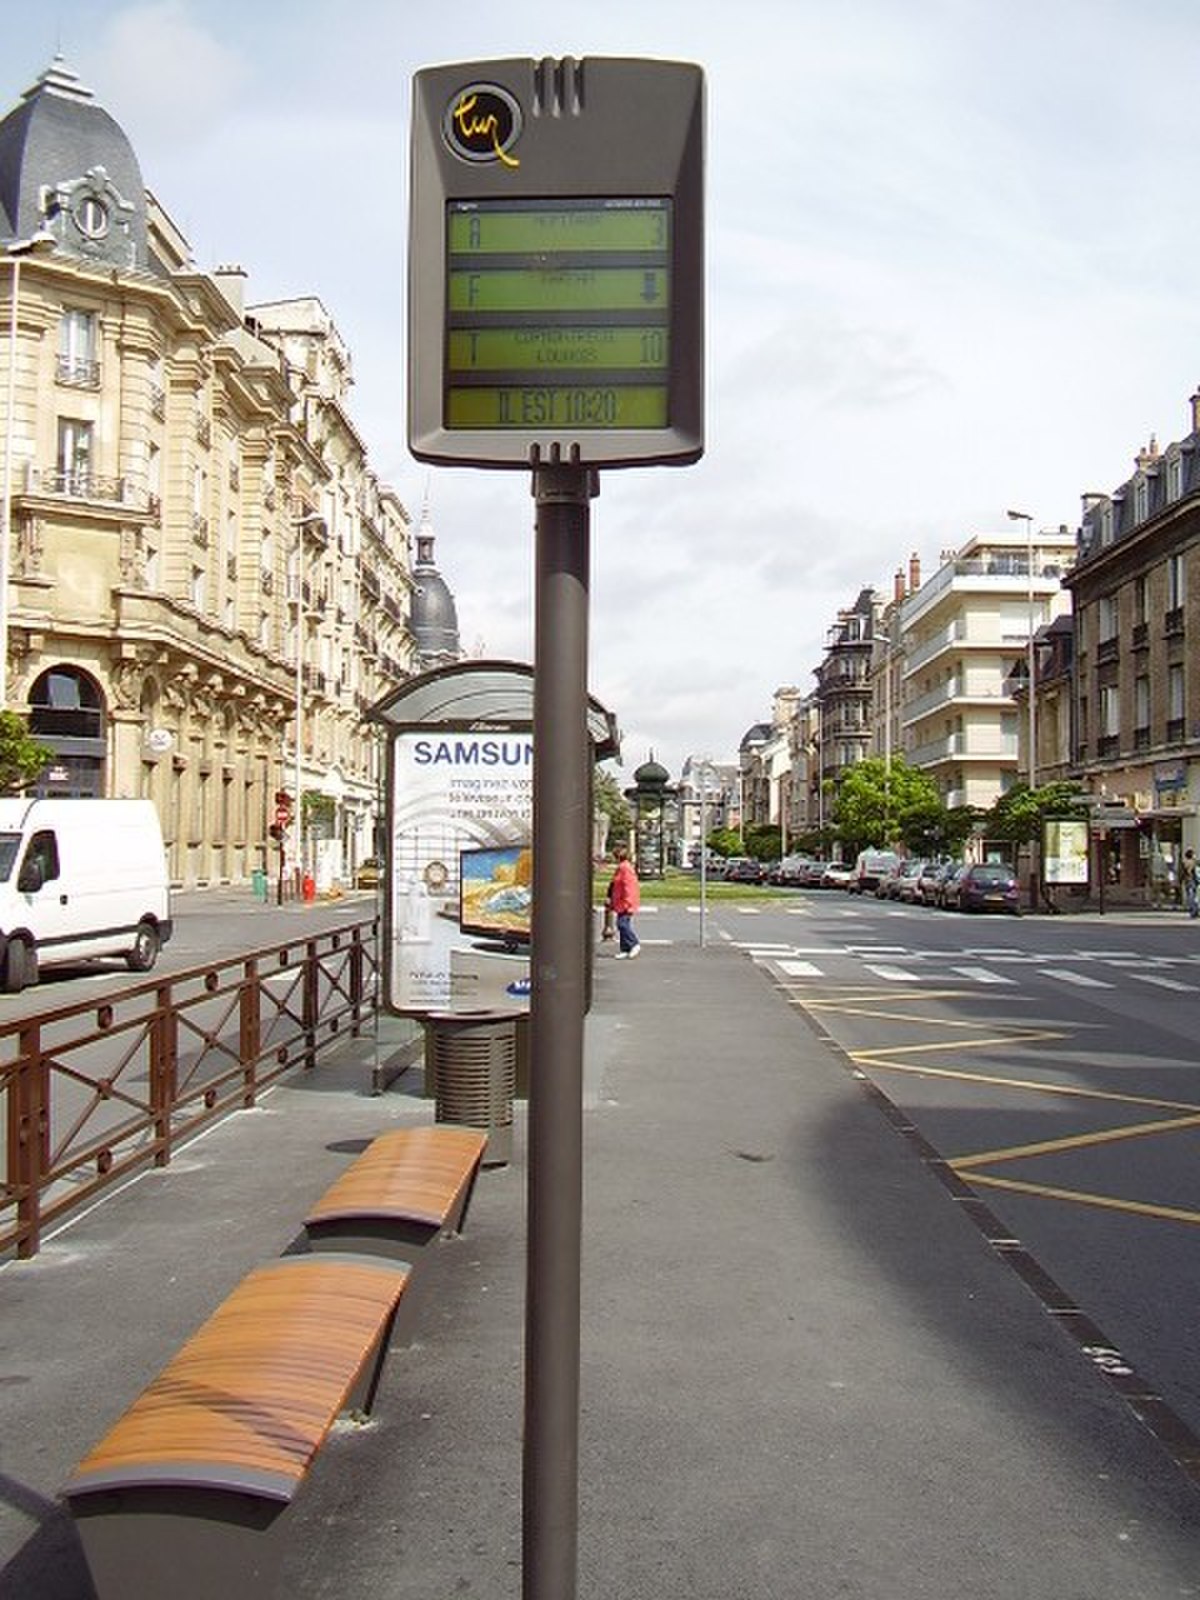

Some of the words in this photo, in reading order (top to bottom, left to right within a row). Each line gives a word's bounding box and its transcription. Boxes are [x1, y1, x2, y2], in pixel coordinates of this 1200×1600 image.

[641, 331, 663, 362] 10
[522, 388, 556, 424] EST
[566, 388, 617, 424] 10:20
